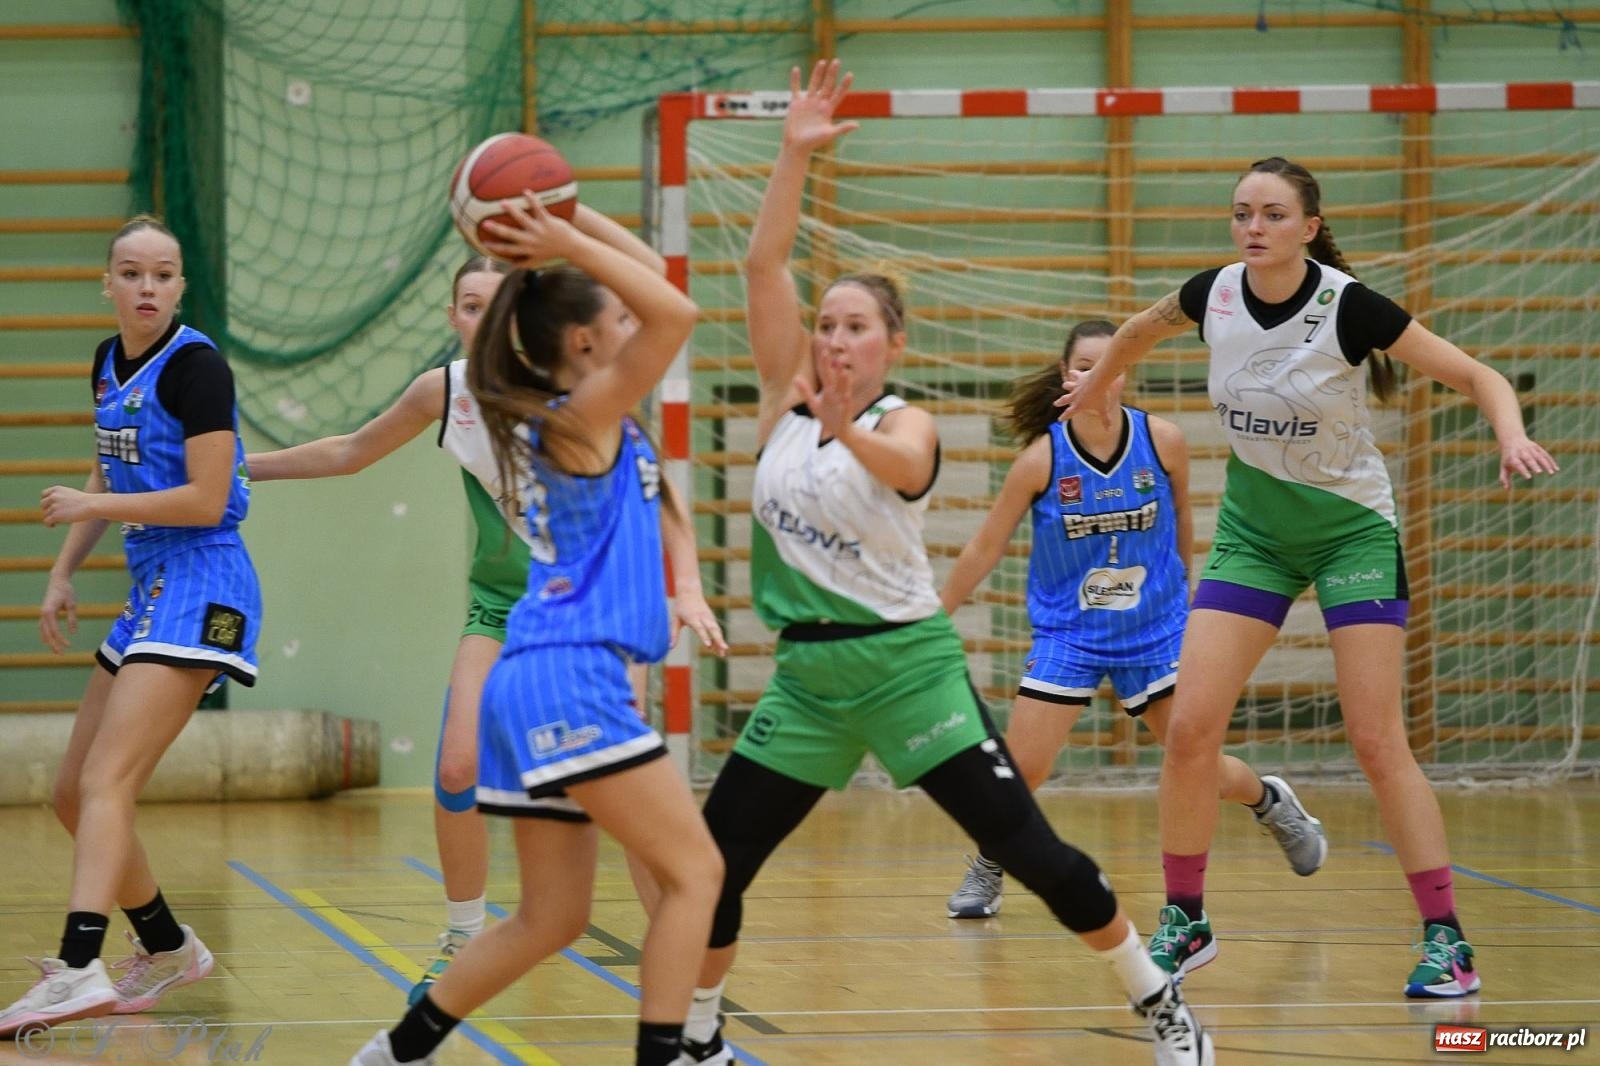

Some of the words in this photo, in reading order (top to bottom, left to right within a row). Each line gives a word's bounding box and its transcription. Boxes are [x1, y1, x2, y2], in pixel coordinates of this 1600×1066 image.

[1304, 314, 1327, 343] 7
[1230, 410, 1319, 437] Clavis
[1062, 500, 1158, 540] SPARTA
[1108, 535, 1120, 564] 1
[1209, 543, 1240, 570] 7
